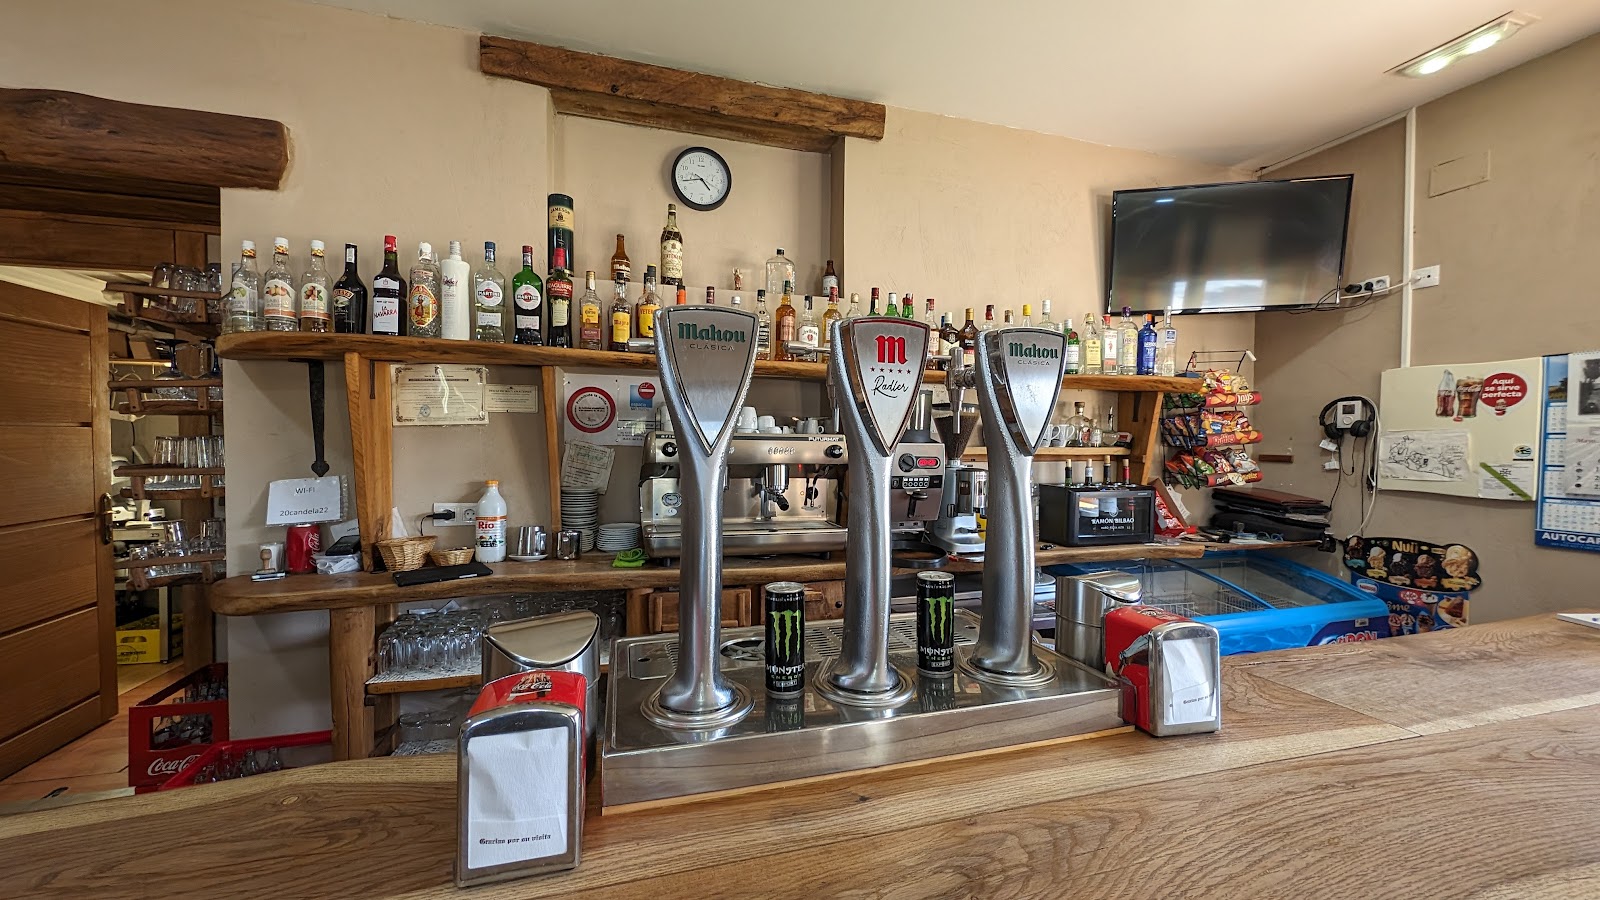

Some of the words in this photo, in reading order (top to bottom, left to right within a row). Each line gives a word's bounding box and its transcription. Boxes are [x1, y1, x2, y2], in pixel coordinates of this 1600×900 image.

[677, 321, 746, 343] Mahou
[689, 343, 735, 351] CLÁSICA
[1008, 342, 1060, 359] Mahou
[871, 375, 909, 399] Radler
[1491, 378, 1514, 386] Aquí
[1496, 384, 1520, 392] sirve
[1481, 391, 1522, 399] perfecta
[279, 506, 329, 517] 20candela22
[479, 837, 506, 845] Gracias
[531, 834, 552, 842] visita
